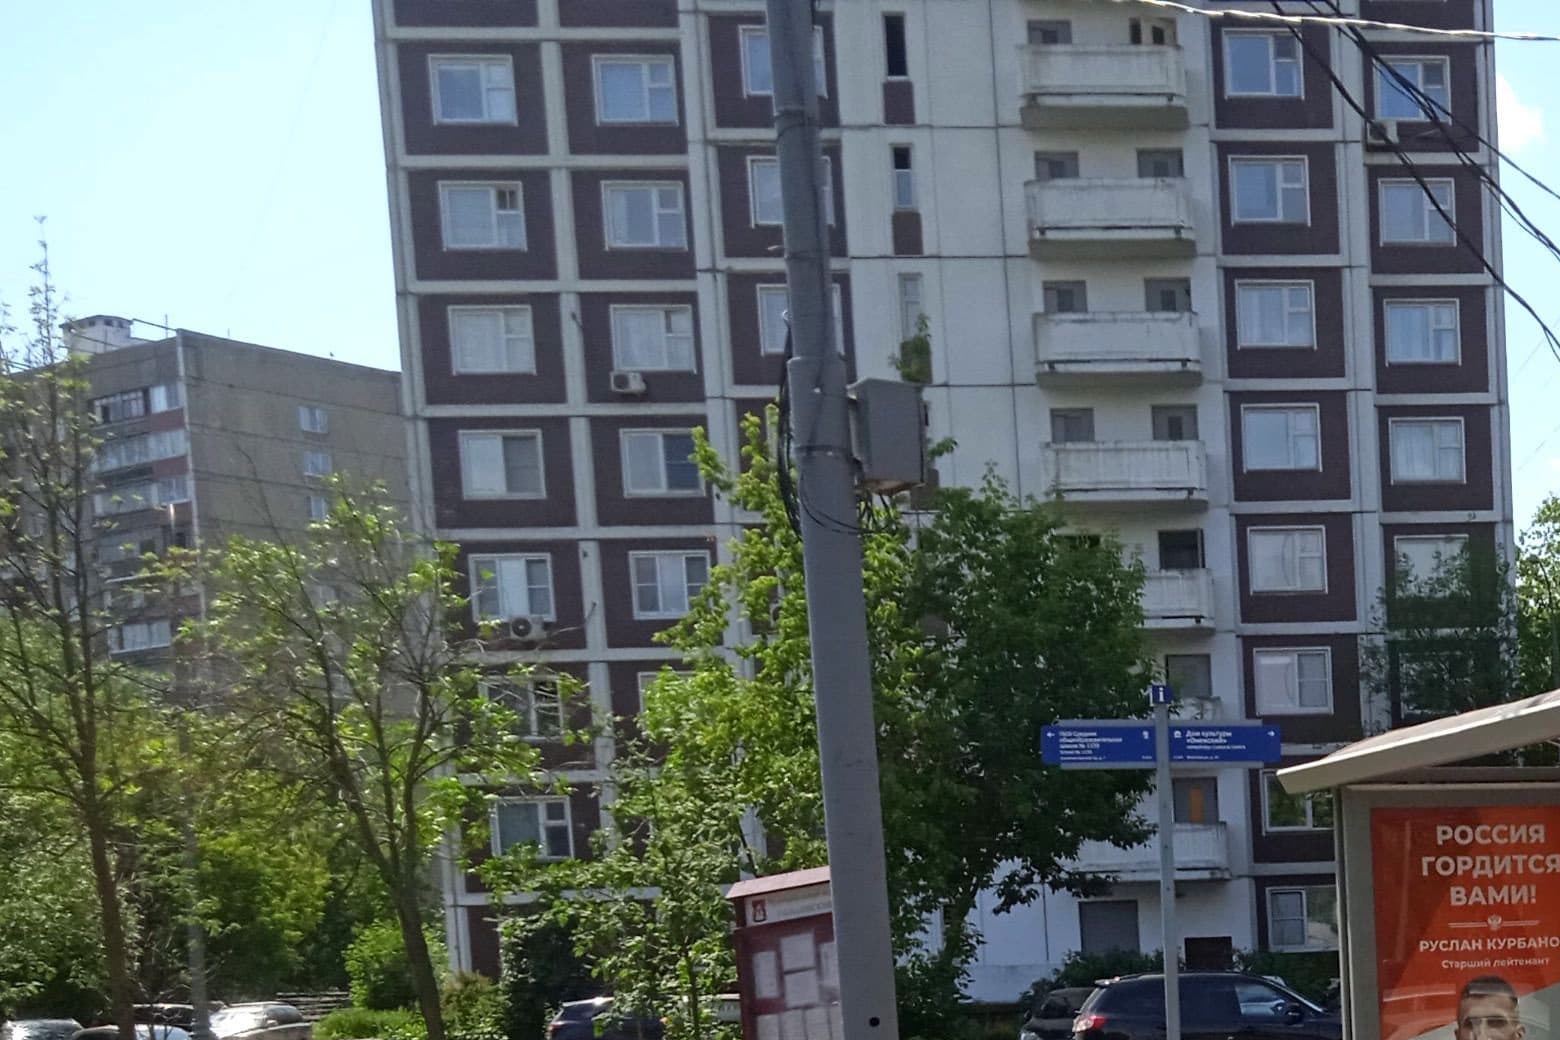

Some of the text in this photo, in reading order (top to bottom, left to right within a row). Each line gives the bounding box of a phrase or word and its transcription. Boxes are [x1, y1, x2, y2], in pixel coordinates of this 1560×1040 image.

[1436, 824, 1546, 846] РОССИЯ
[1450, 885, 1537, 906] ВАМИ!
[1419, 938, 1483, 952] РУСЛАН
[1441, 957, 1550, 969] Старший лейтенант
